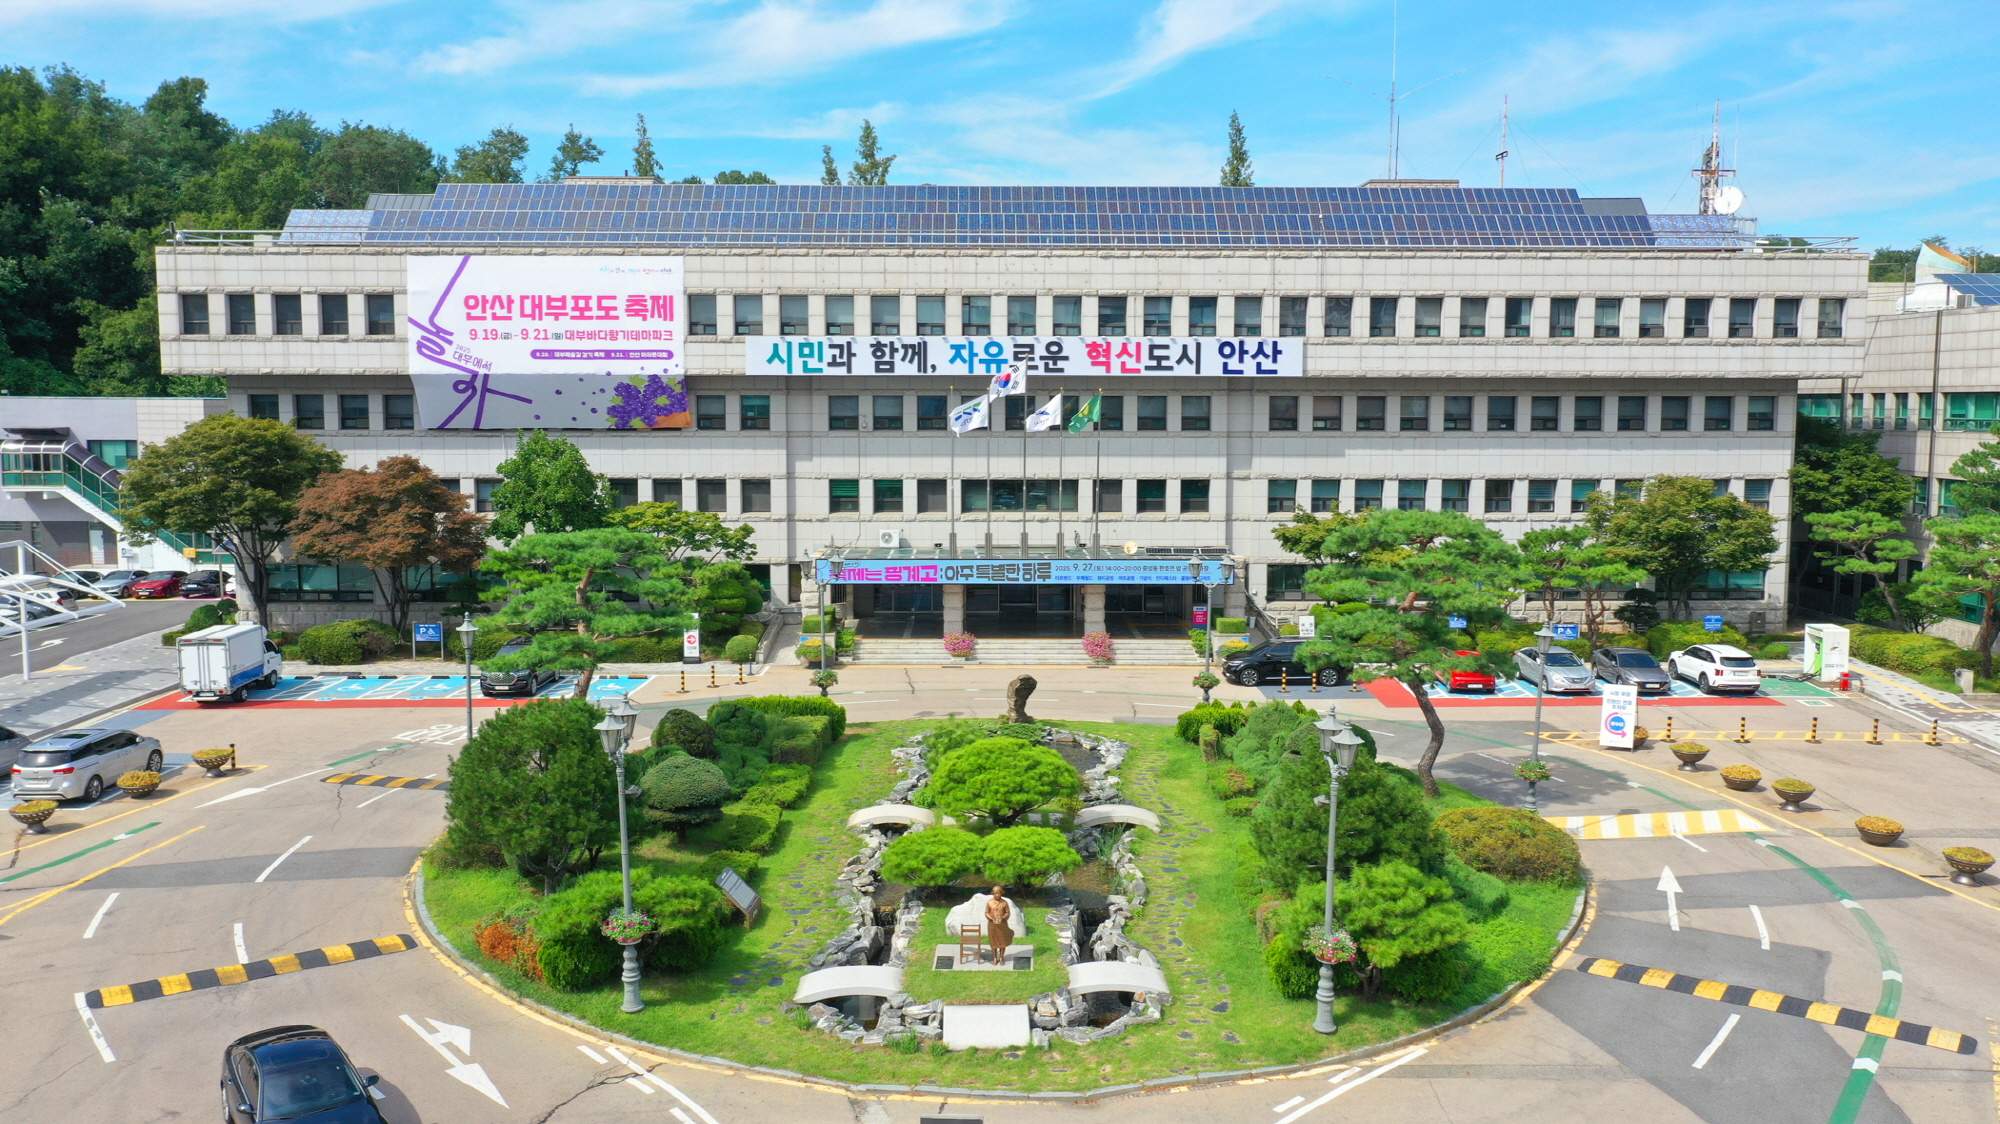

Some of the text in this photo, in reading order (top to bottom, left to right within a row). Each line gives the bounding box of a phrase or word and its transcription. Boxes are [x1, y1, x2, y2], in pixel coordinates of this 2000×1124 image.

[464, 294, 675, 322] 안산 대부포도 축제
[564, 329, 674, 342] 대부바다향기테마파크
[455, 344, 471, 353] 2025
[766, 340, 1283, 375] 시민과 함께, 자유로운 혁신도시 안산
[453, 350, 493, 372] 대부에서
[944, 565, 974, 581] 아주
[975, 563, 1021, 582] 특별한
[1022, 562, 1052, 582] 하루
